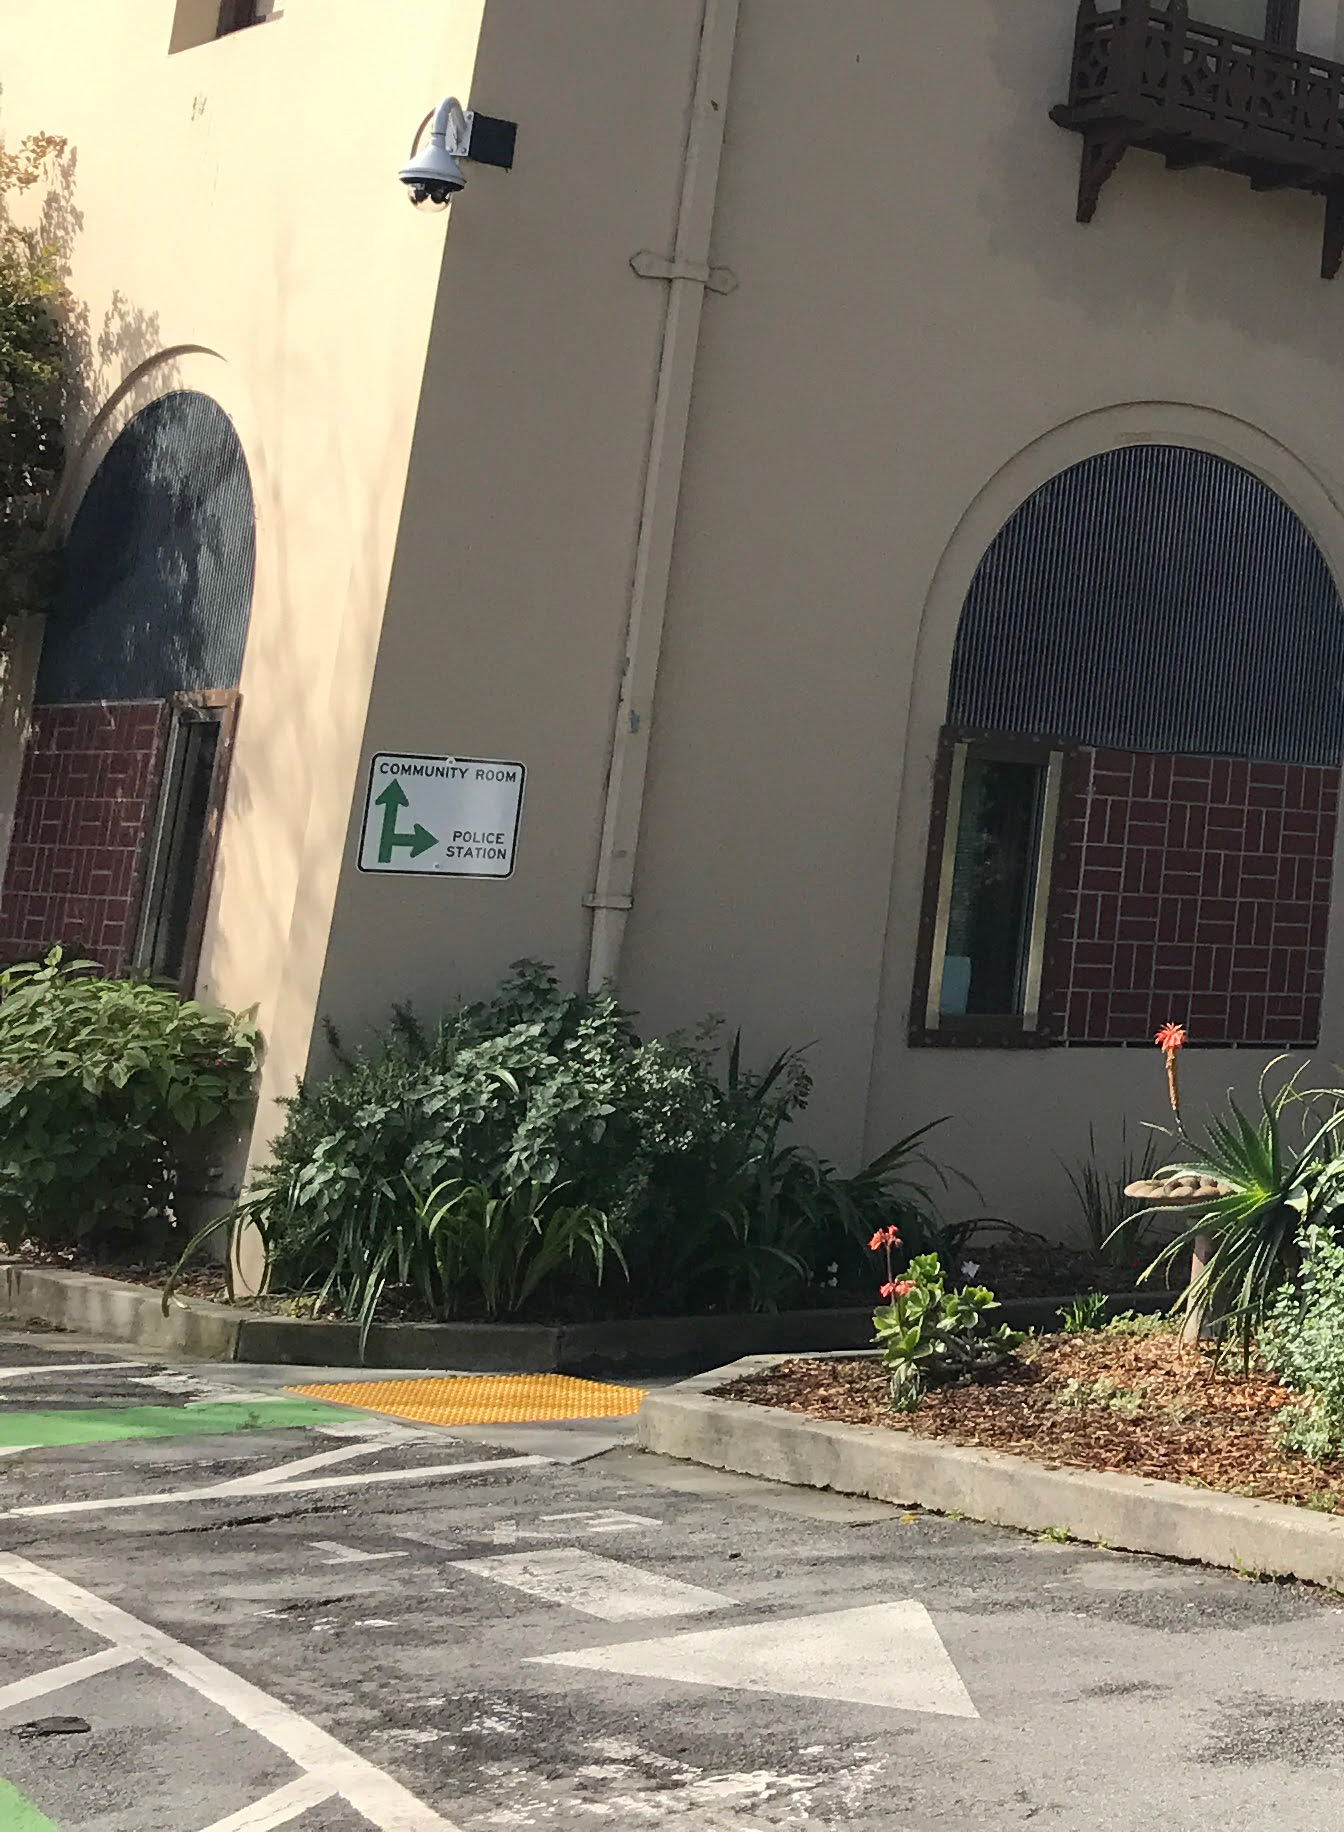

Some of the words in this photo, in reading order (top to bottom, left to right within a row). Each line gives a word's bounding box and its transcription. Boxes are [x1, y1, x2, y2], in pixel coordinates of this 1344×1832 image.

[379, 762, 469, 779] COMMUNITY
[475, 770, 517, 783] ROOM
[452, 831, 505, 845] POLICE
[446, 847, 507, 860] STATION
